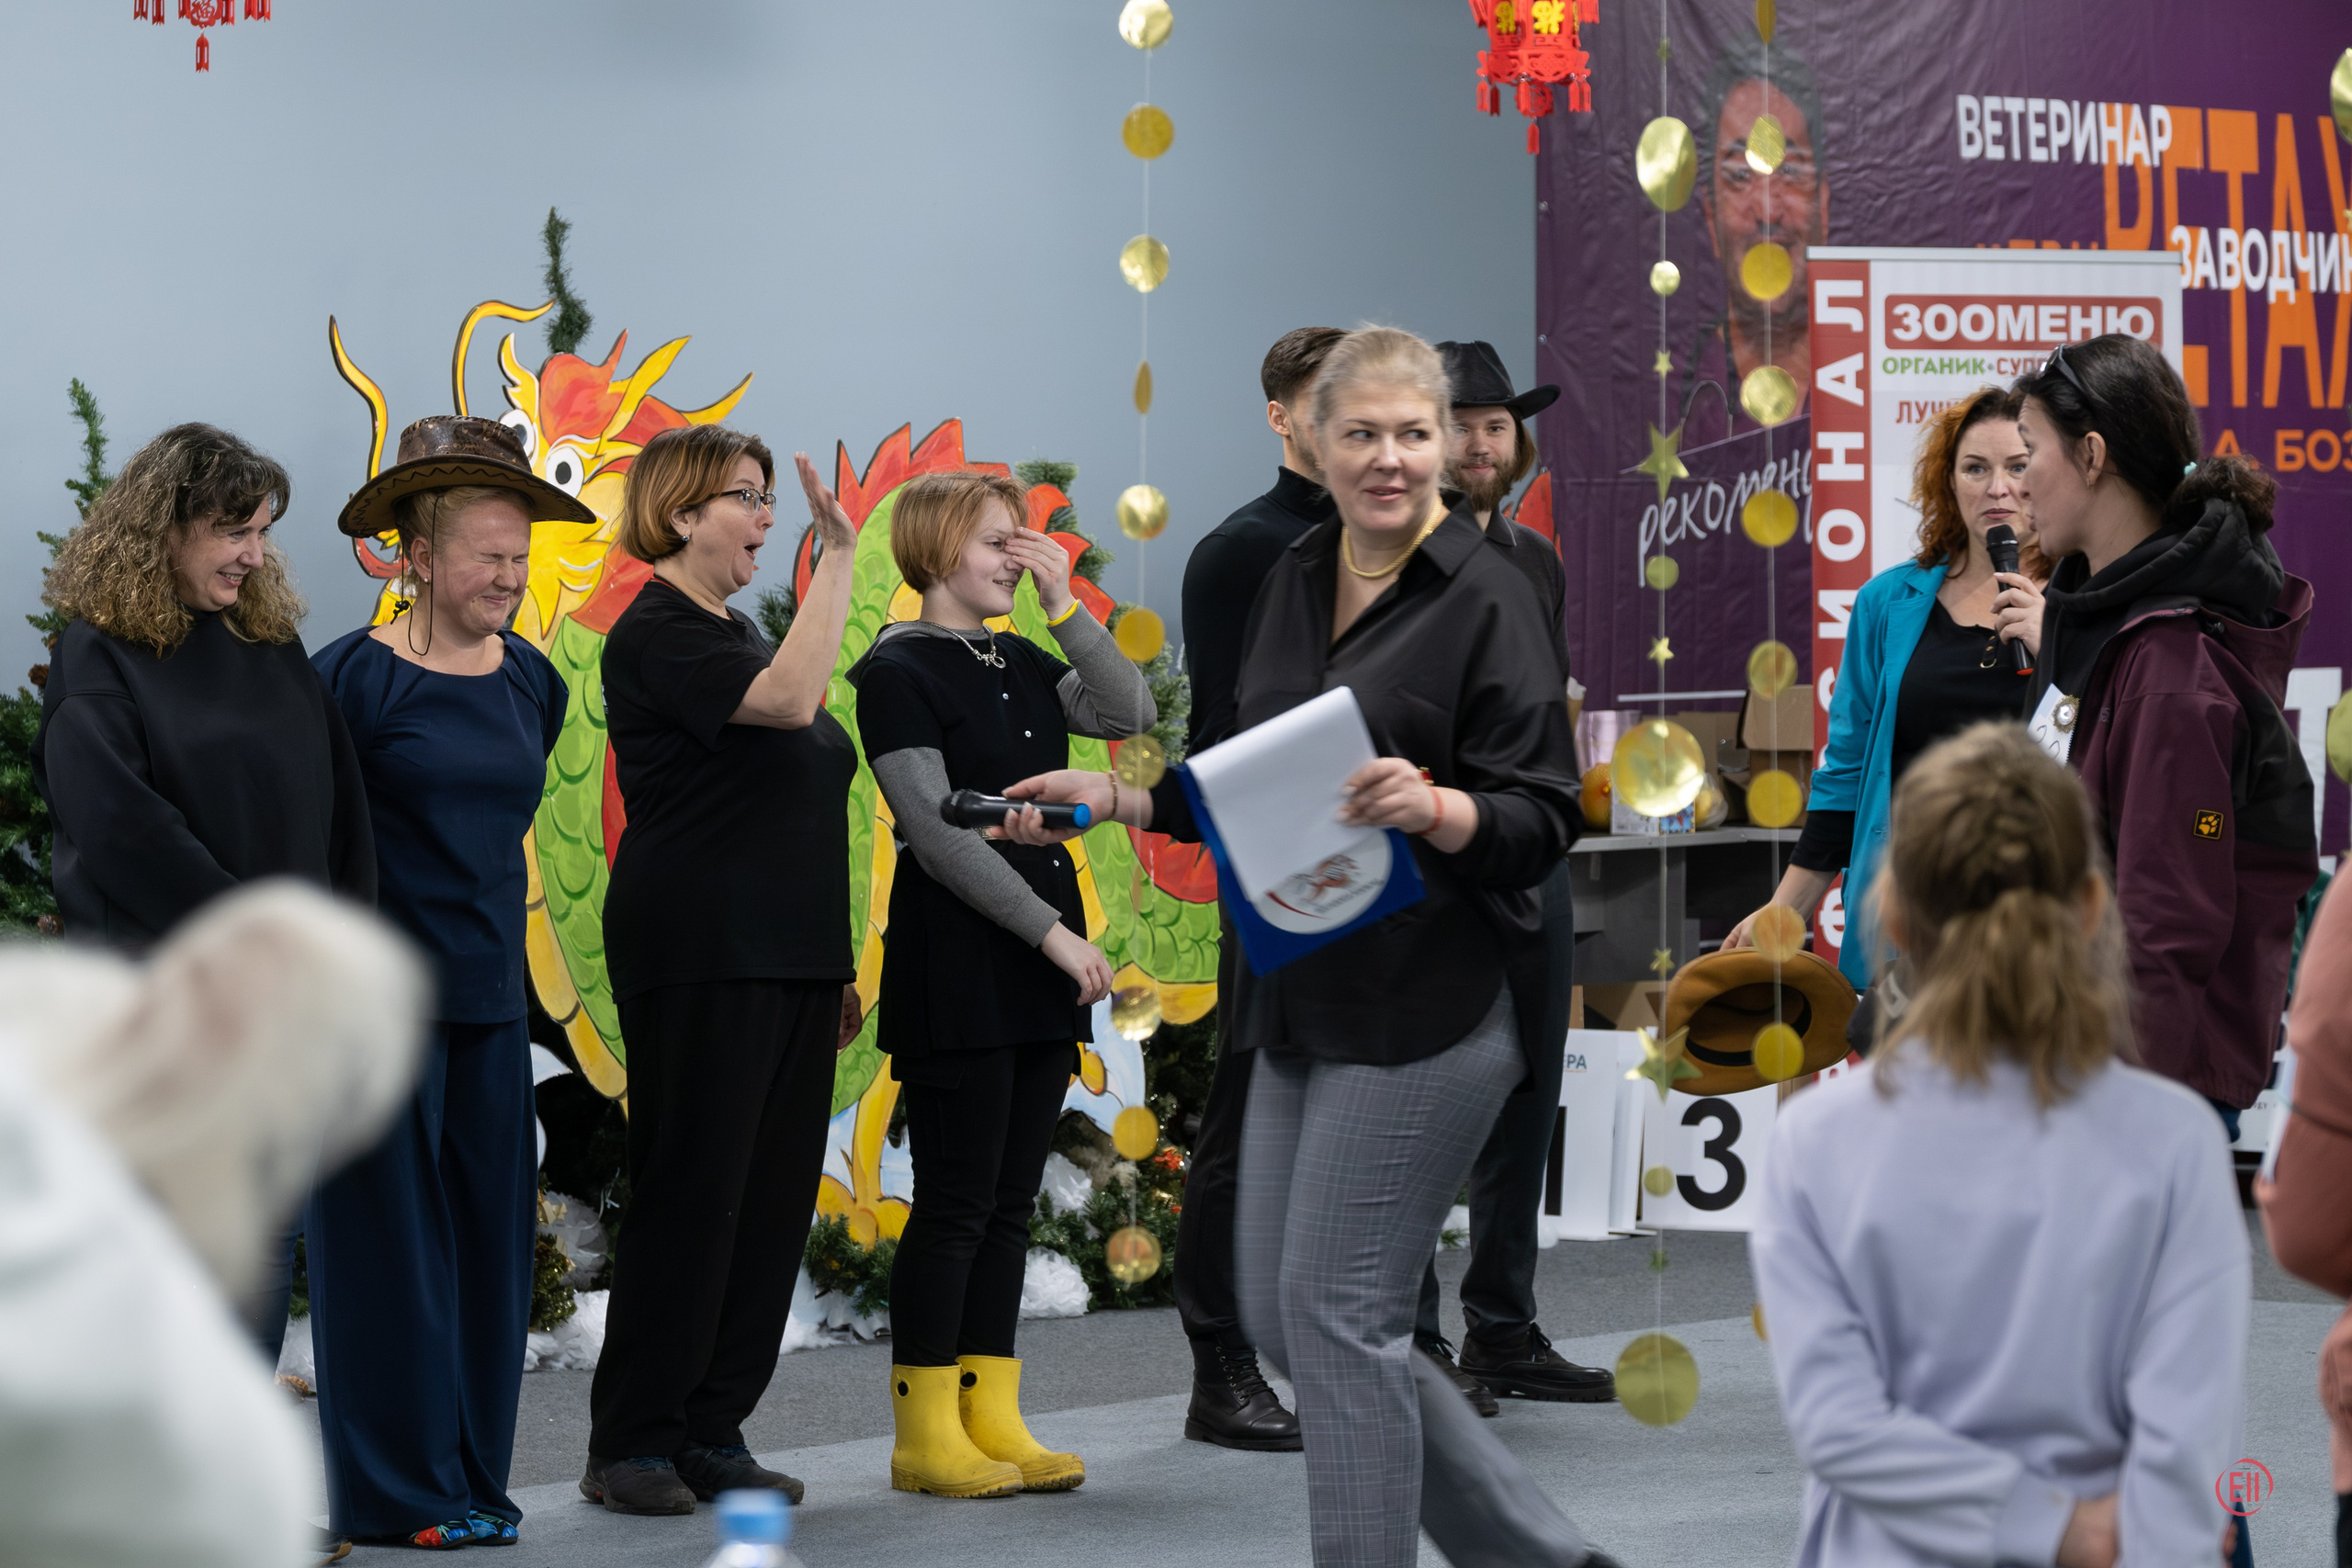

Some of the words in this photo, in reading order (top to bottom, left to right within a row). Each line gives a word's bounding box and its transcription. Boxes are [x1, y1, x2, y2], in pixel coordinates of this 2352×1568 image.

[1956, 94, 2173, 168] ВЕТЕРИНАР
[1892, 302, 2155, 343] ЗООМЕНЮ
[1564, 1054, 1588, 1069] РА
[1676, 1098, 1747, 1212] 3
